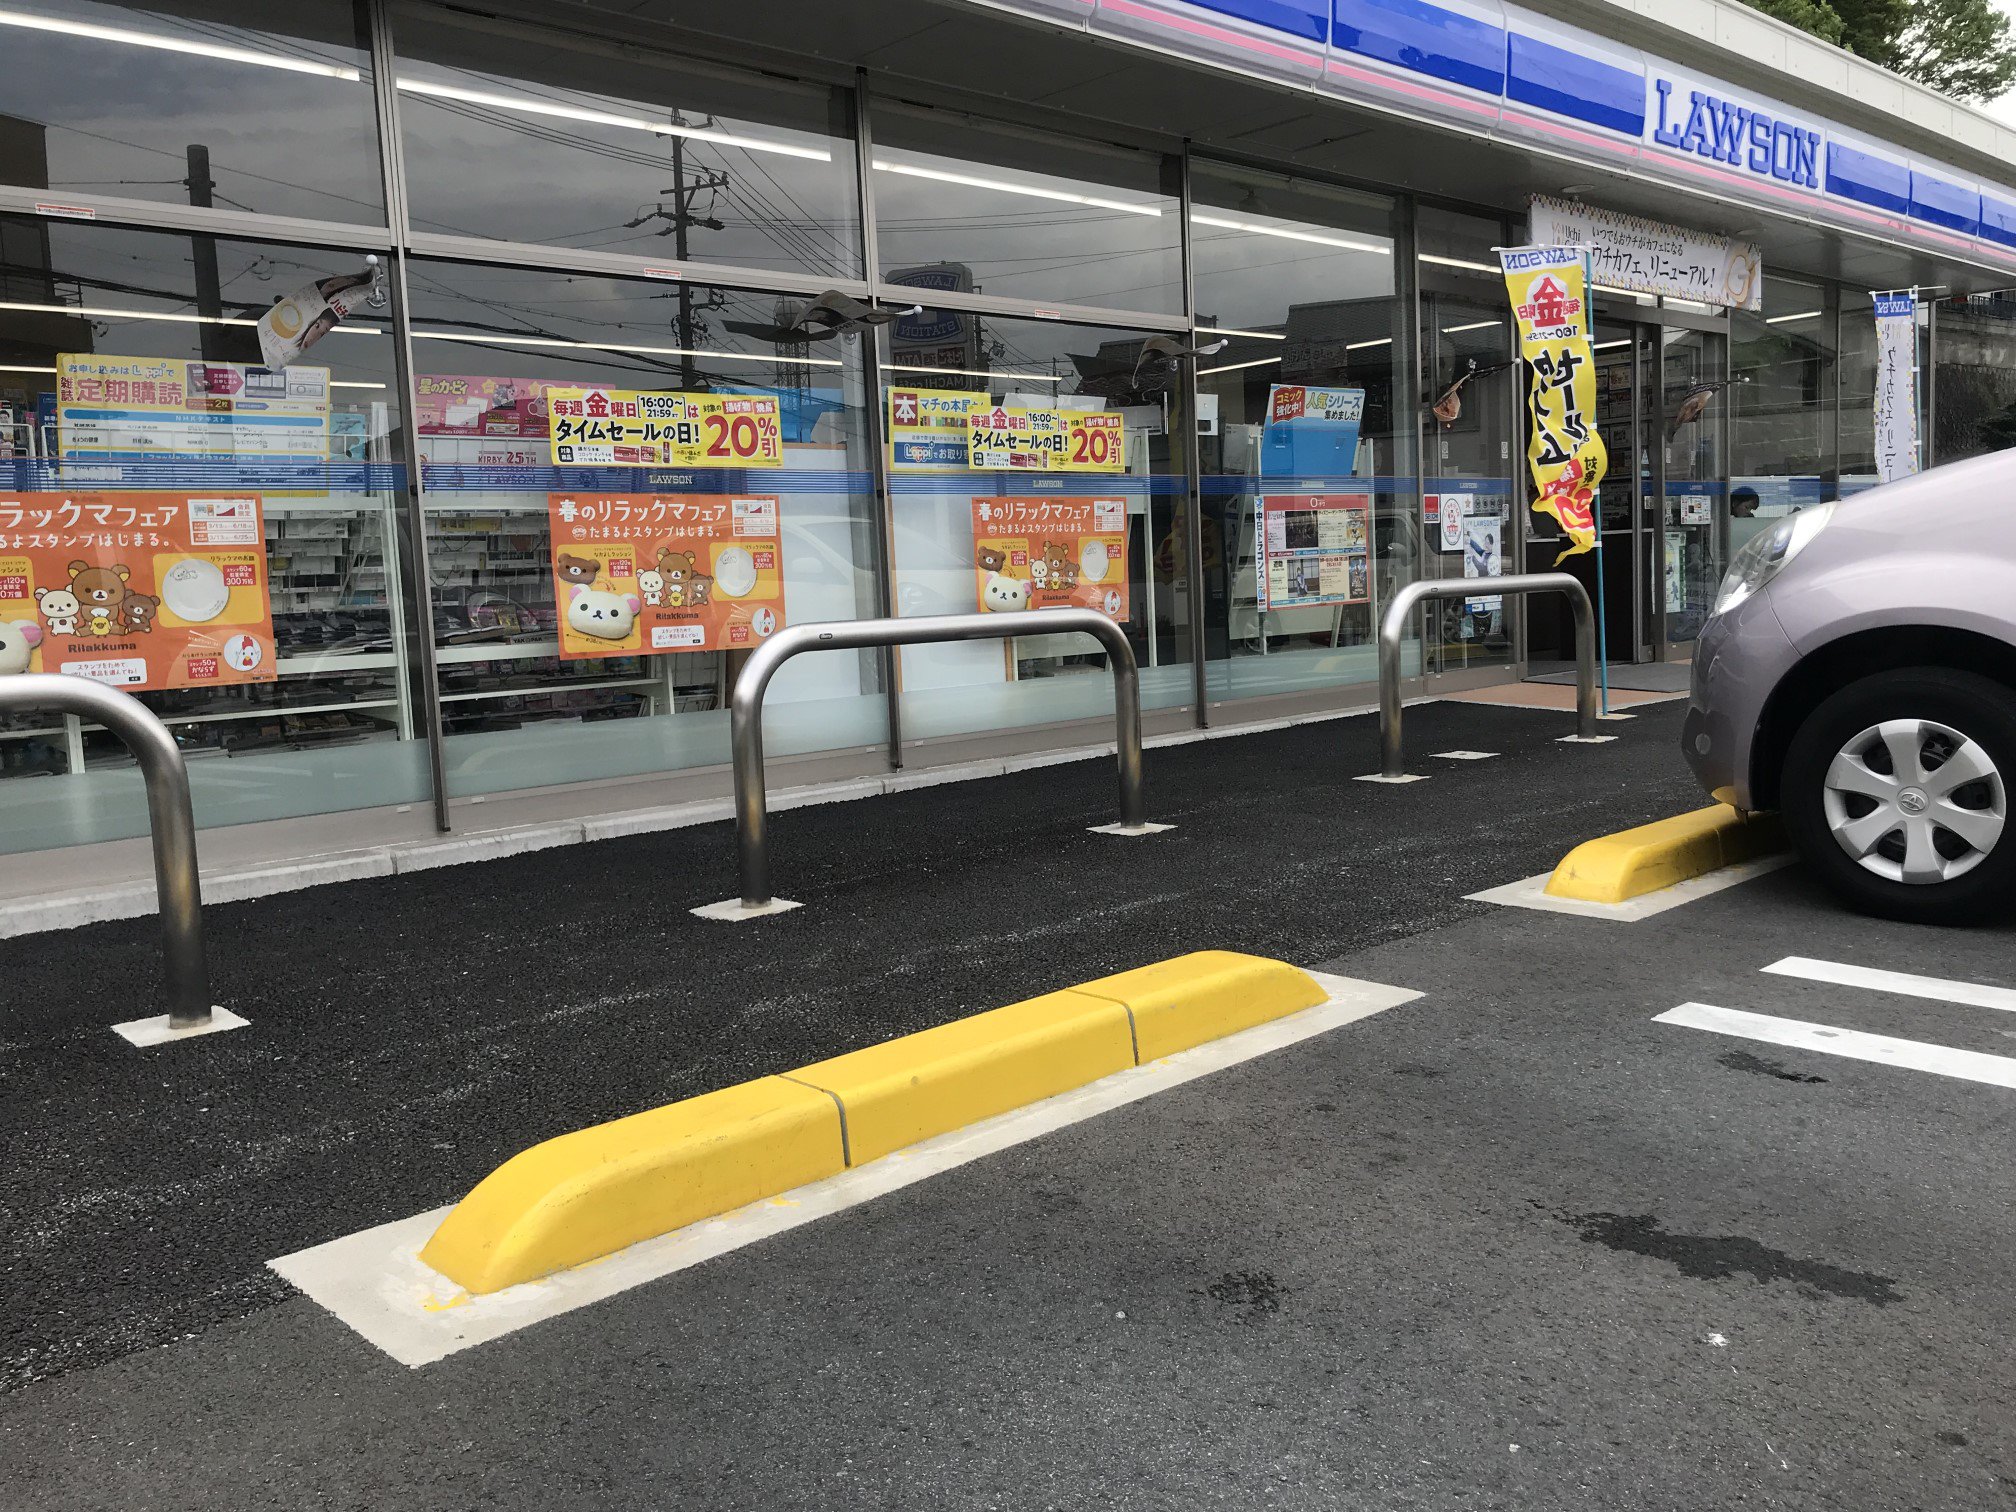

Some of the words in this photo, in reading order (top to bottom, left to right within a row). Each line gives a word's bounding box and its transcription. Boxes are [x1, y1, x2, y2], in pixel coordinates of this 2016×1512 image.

[1655, 79, 1821, 189] LAWSON
[1565, 225, 1581, 241] Uchi
[1591, 226, 1684, 257] いつでもおウチがカフェになる
[77, 379, 183, 406] 定期購読
[1276, 389, 1303, 404] コミック
[1306, 391, 1362, 409] 人気シリーズ
[553, 391, 637, 418] 毎週金曜日
[895, 396, 917, 423] 本
[1276, 401, 1302, 417] 強化中!
[1324, 410, 1360, 421] 集めました!
[556, 418, 700, 444] タイムセールの日!
[972, 430, 1068, 452] タイムセールの日!
[478, 456, 502, 464] KIRBY
[649, 474, 693, 484] LAWSON
[1032, 479, 1064, 488] LAWSON
[558, 499, 727, 523] 春のリラックマフェア
[978, 501, 1091, 522] 春のリラックマフェア
[589, 525, 720, 538] たまるよスタンプはじまる。
[999, 523, 1087, 535] たまるよスタンプはじまる。
[1256, 512, 1265, 580] 中日ドラゴンズ
[655, 612, 700, 620] Rilakkuma
[68, 642, 137, 653] Rilakkuma
